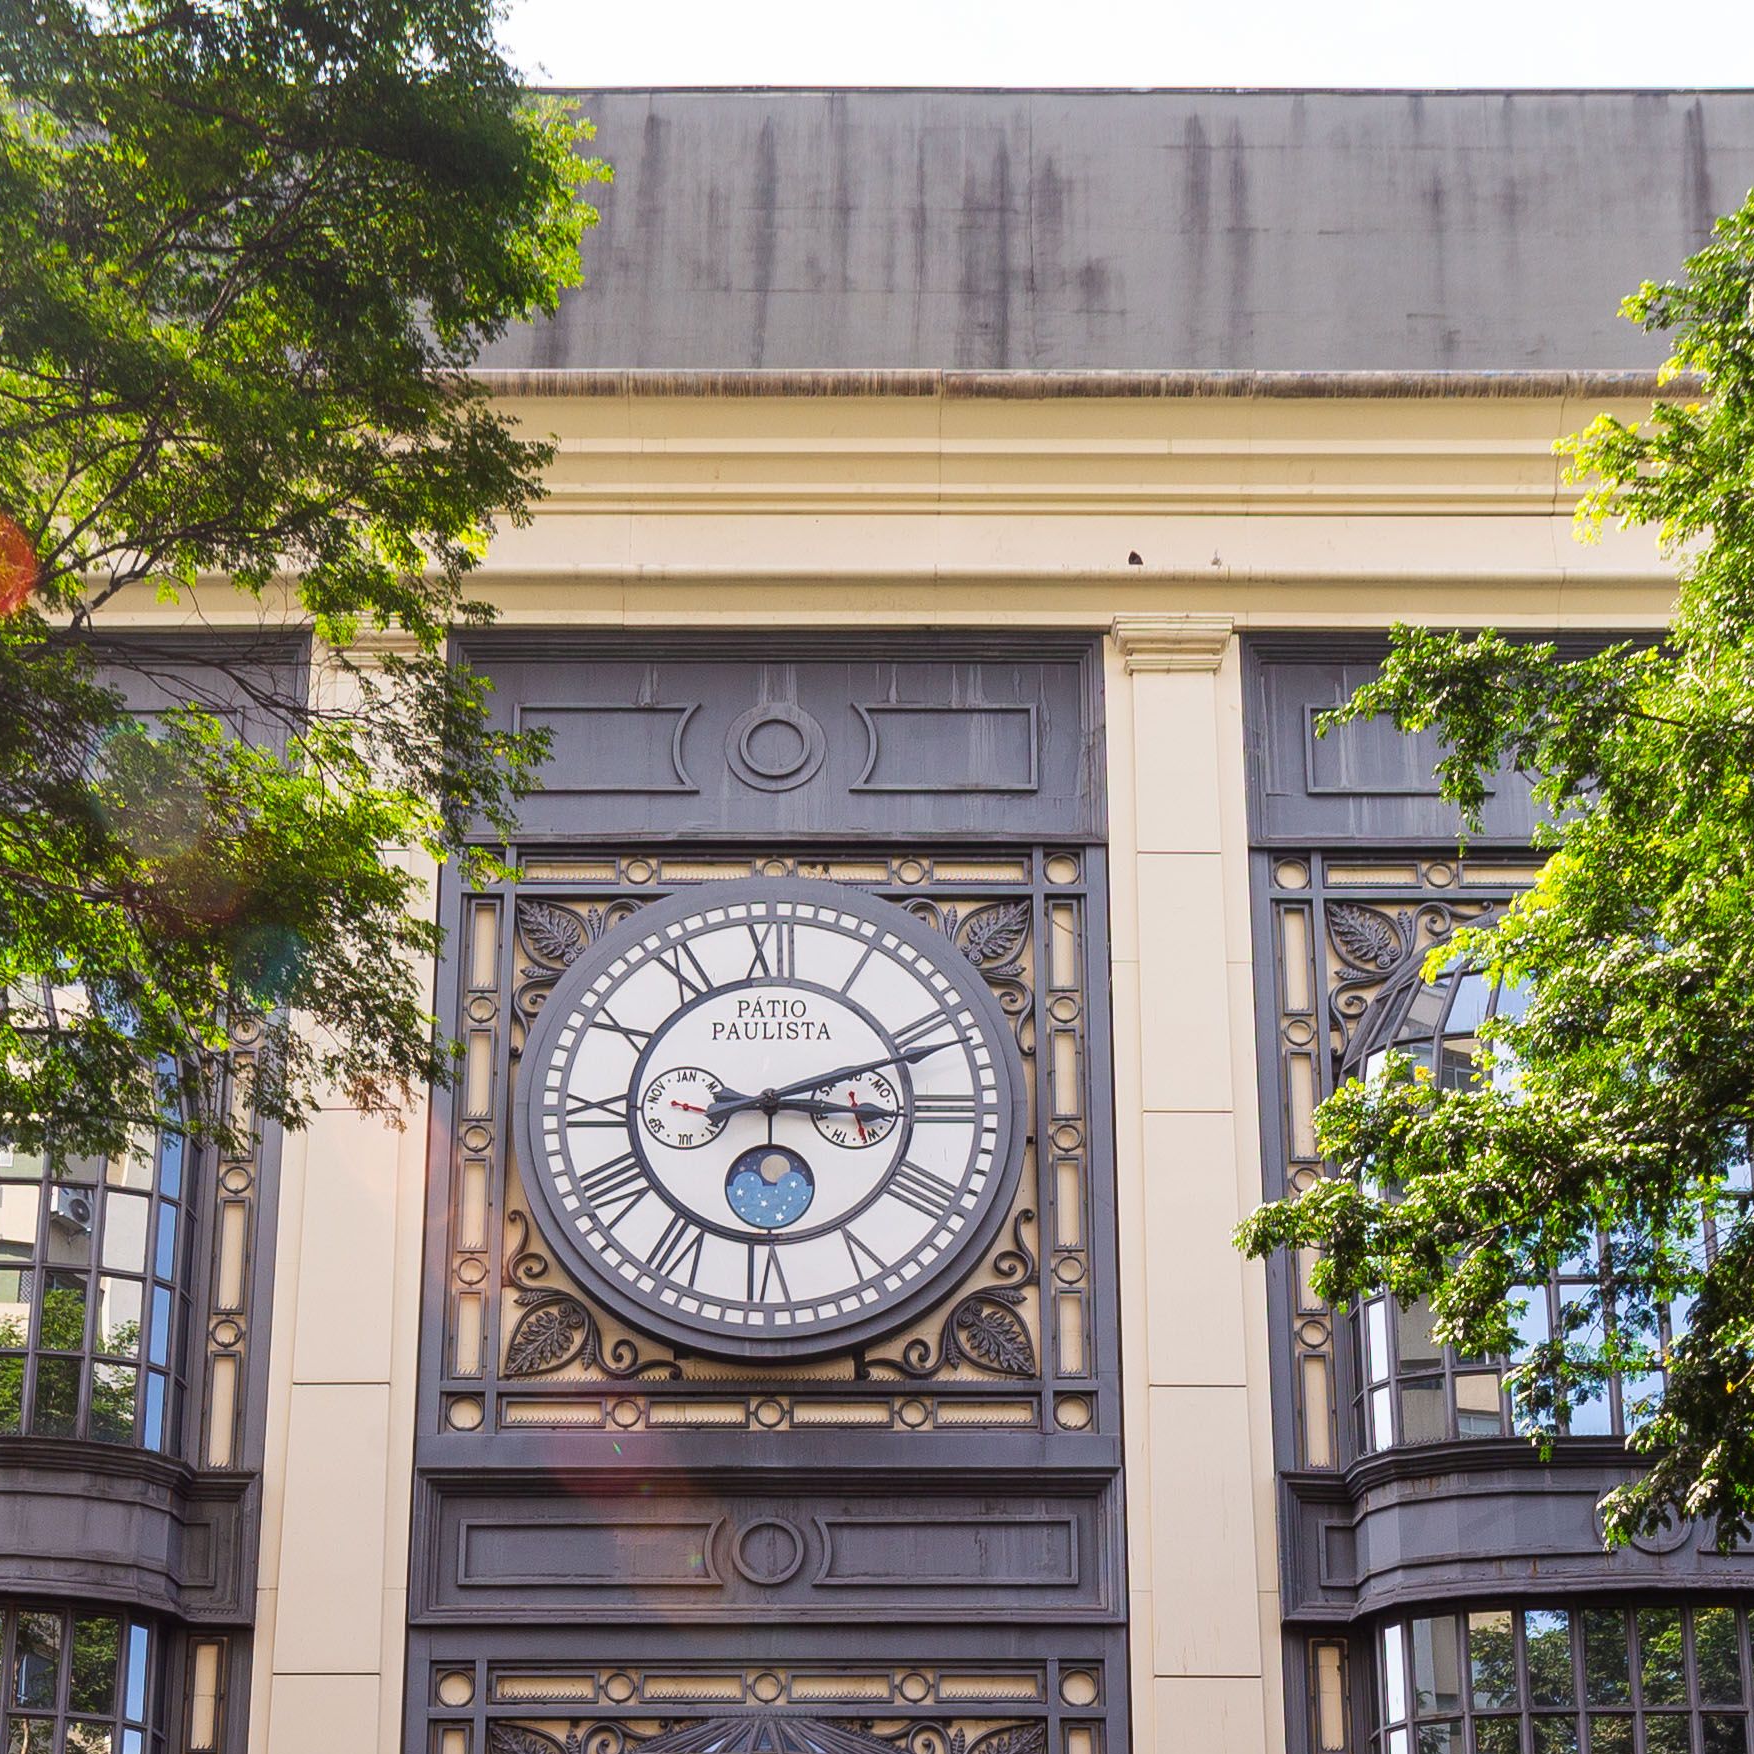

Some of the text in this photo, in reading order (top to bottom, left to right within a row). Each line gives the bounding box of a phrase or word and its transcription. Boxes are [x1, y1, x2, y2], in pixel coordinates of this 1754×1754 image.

[737, 995, 806, 1018] PÁTIO
[712, 1021, 831, 1040] PAULISTA
[676, 1071, 697, 1083] JAN
[647, 1081, 666, 1104] NOV
[871, 1079, 891, 1098] MO
[648, 1117, 665, 1133] SEP
[678, 1133, 693, 1145] JUL
[832, 1128, 847, 1144] TH
